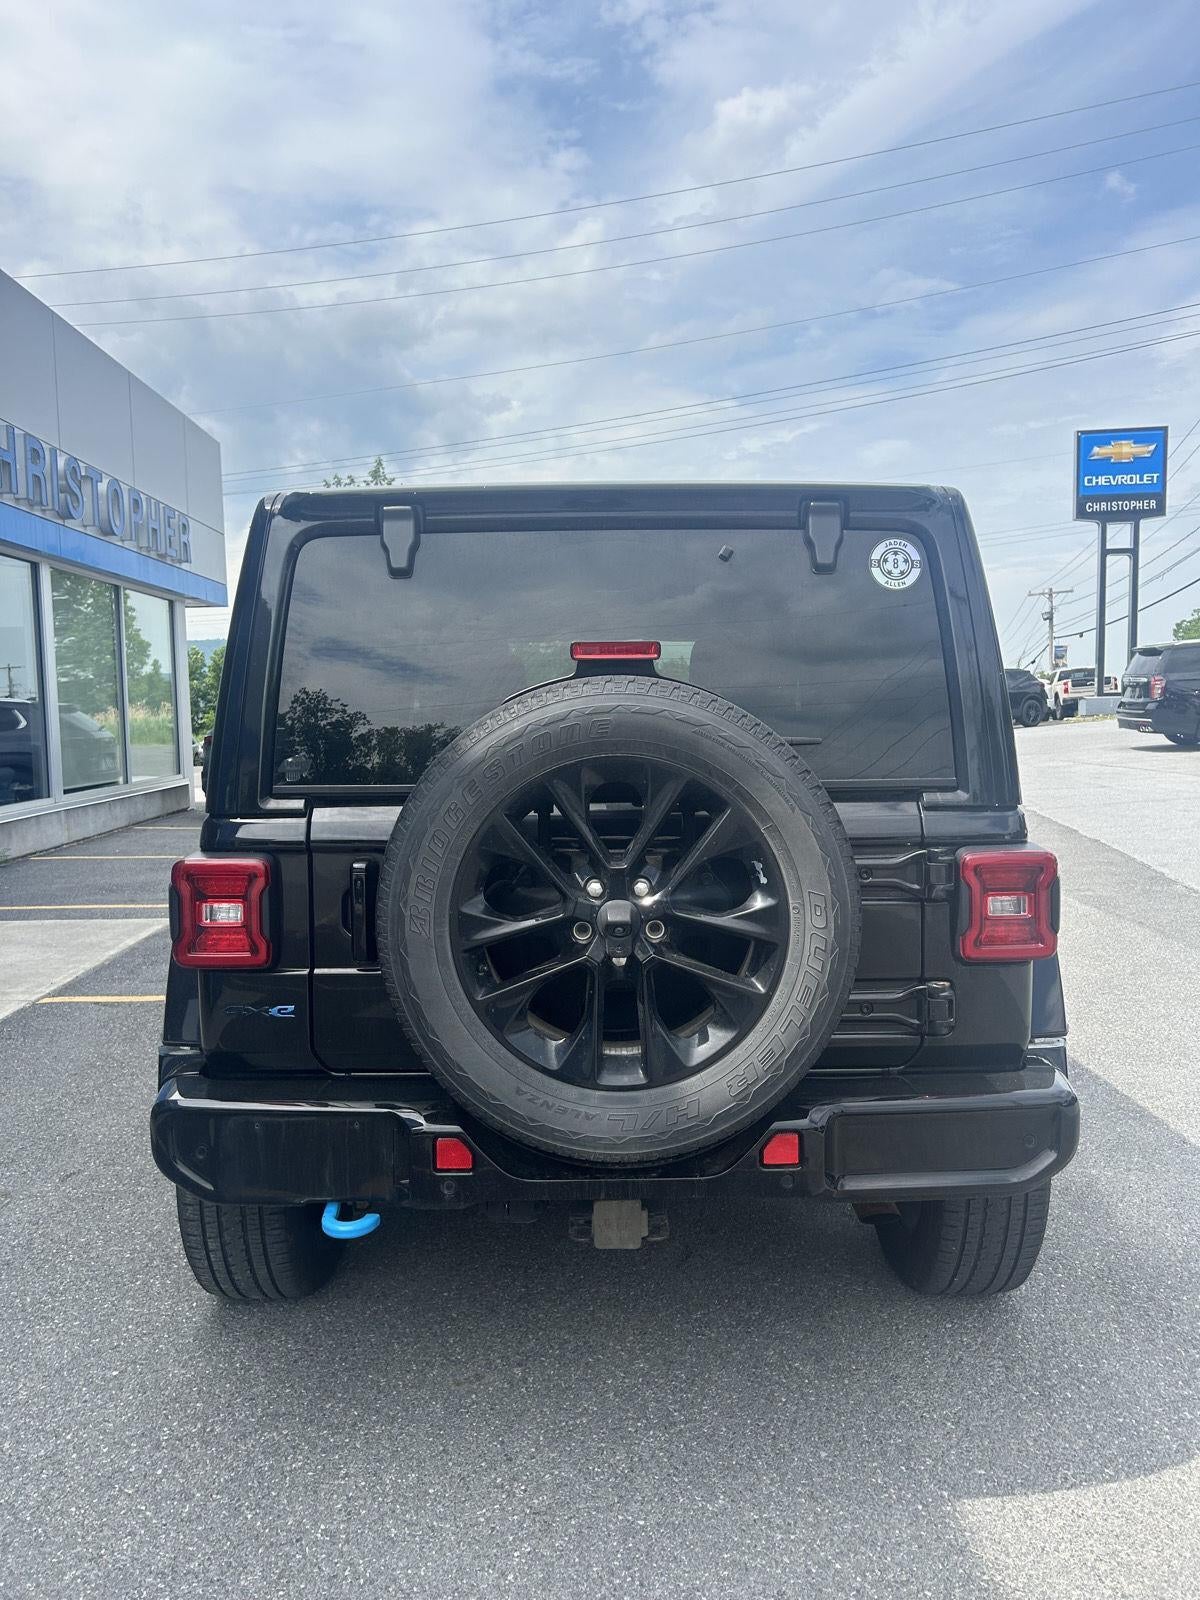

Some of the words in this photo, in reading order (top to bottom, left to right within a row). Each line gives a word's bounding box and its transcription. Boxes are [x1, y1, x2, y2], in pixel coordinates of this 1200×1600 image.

[1083, 473, 1160, 487] CHEVROLET
[1085, 499, 1157, 513] CHRISTOPHER
[884, 540, 908, 548] JADEN
[893, 558, 899, 568] 8
[409, 717, 612, 940] BRIDGESTONE
[726, 890, 827, 1096] DUELER
[515, 1085, 601, 1122] ALENZA
[607, 1096, 700, 1132] H/L
